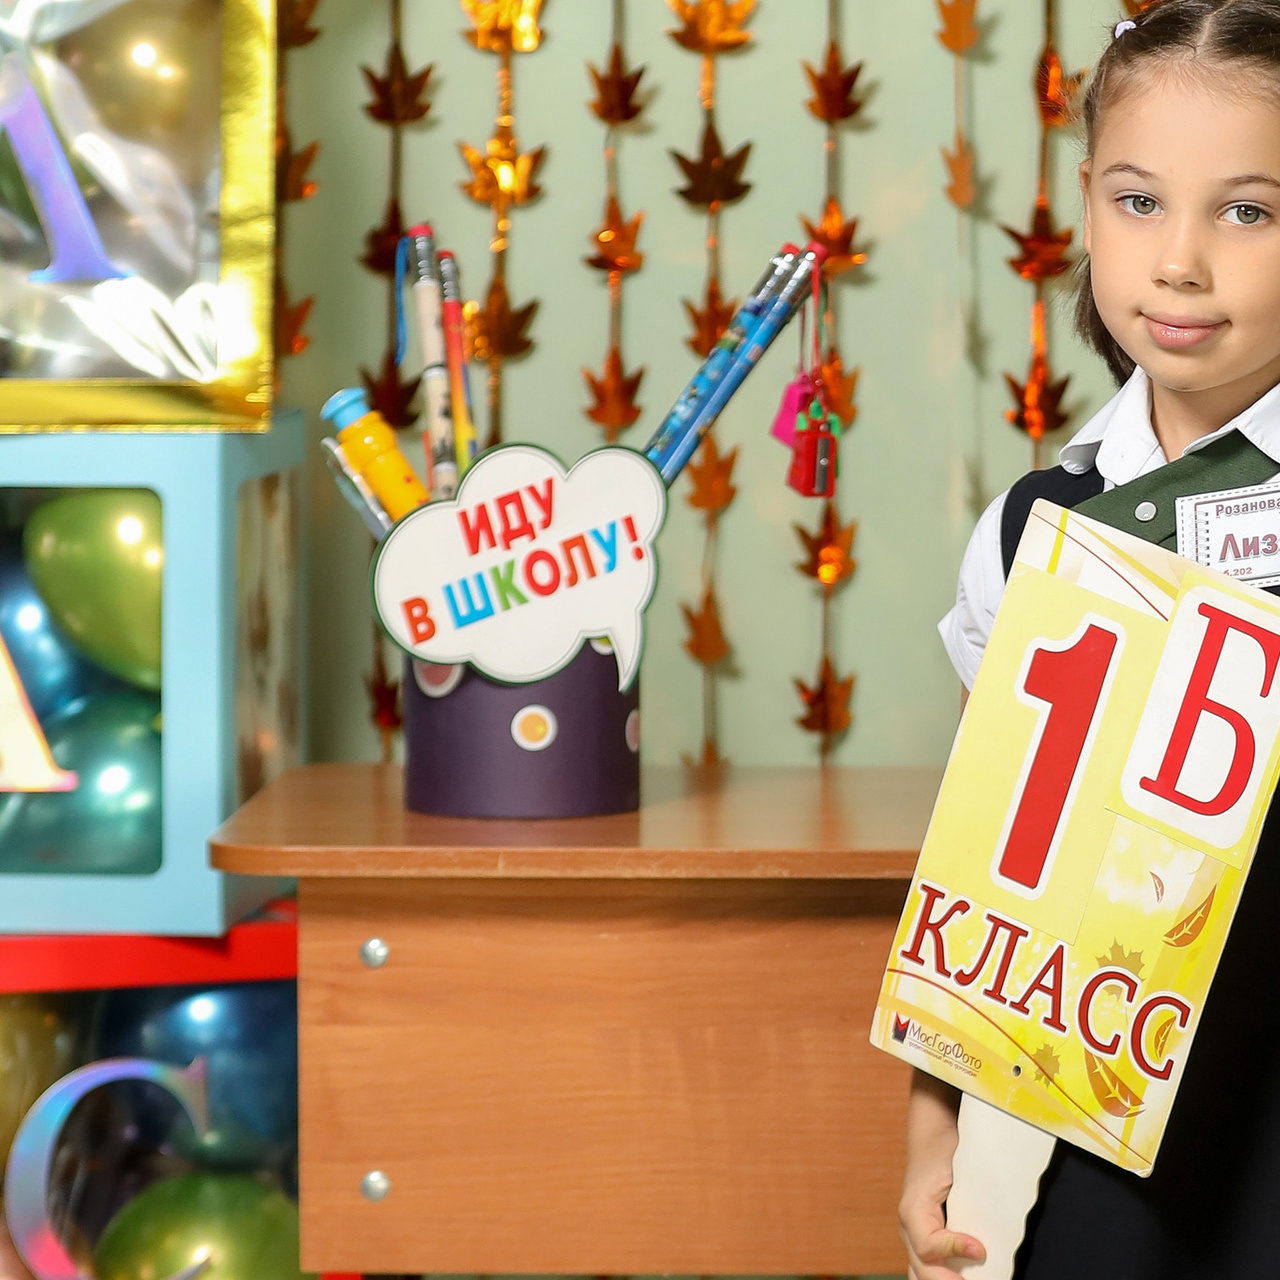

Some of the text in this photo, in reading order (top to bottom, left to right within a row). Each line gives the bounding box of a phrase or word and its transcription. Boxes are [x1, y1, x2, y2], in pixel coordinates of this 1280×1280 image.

[401, 514, 645, 646] В ШКОЛУ!
[457, 477, 554, 556] ИДУ
[998, 623, 1118, 890] 1
[900, 883, 1192, 1082] КЛАСС
[908, 1022, 983, 1070] МосГорФото
